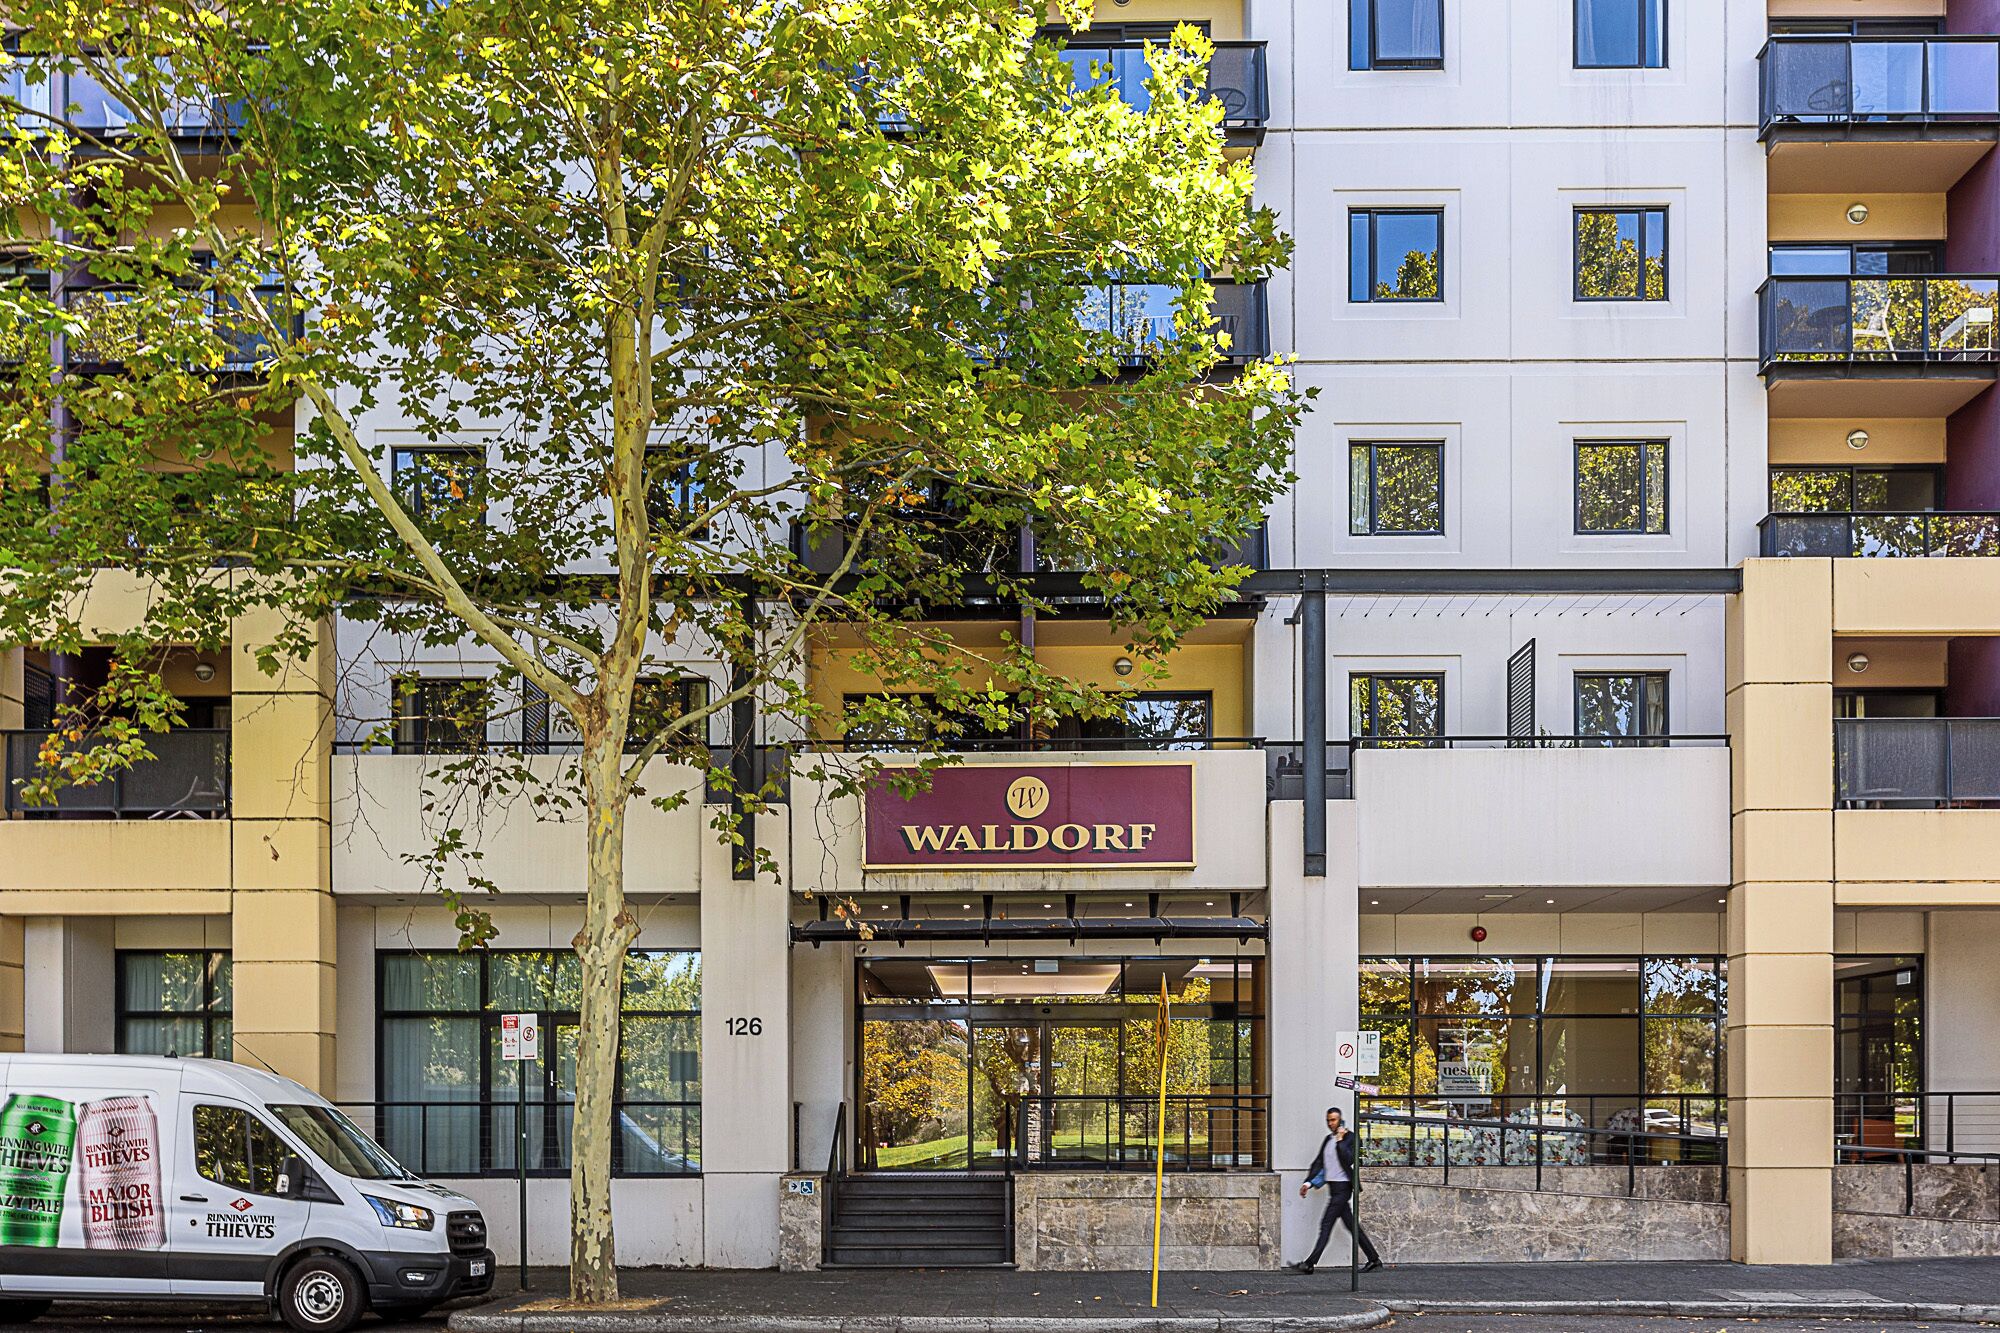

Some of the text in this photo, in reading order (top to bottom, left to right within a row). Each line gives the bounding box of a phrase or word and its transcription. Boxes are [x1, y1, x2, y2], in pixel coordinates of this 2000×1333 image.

[1012, 786, 1043, 808] W
[899, 823, 1156, 853] WALDORF
[725, 1017, 762, 1036] 126
[1366, 1033, 1377, 1044] 1P
[43, 1141, 69, 1155] WITH
[85, 1138, 148, 1154] RUNNING WITH
[86, 1147, 150, 1168] THIEVES
[89, 1183, 152, 1205] MAJOR
[28, 1197, 60, 1213] PALE
[91, 1199, 154, 1223] BLUSH
[207, 1213, 275, 1224] RUNNING WITH
[205, 1222, 275, 1239] THIEVES
